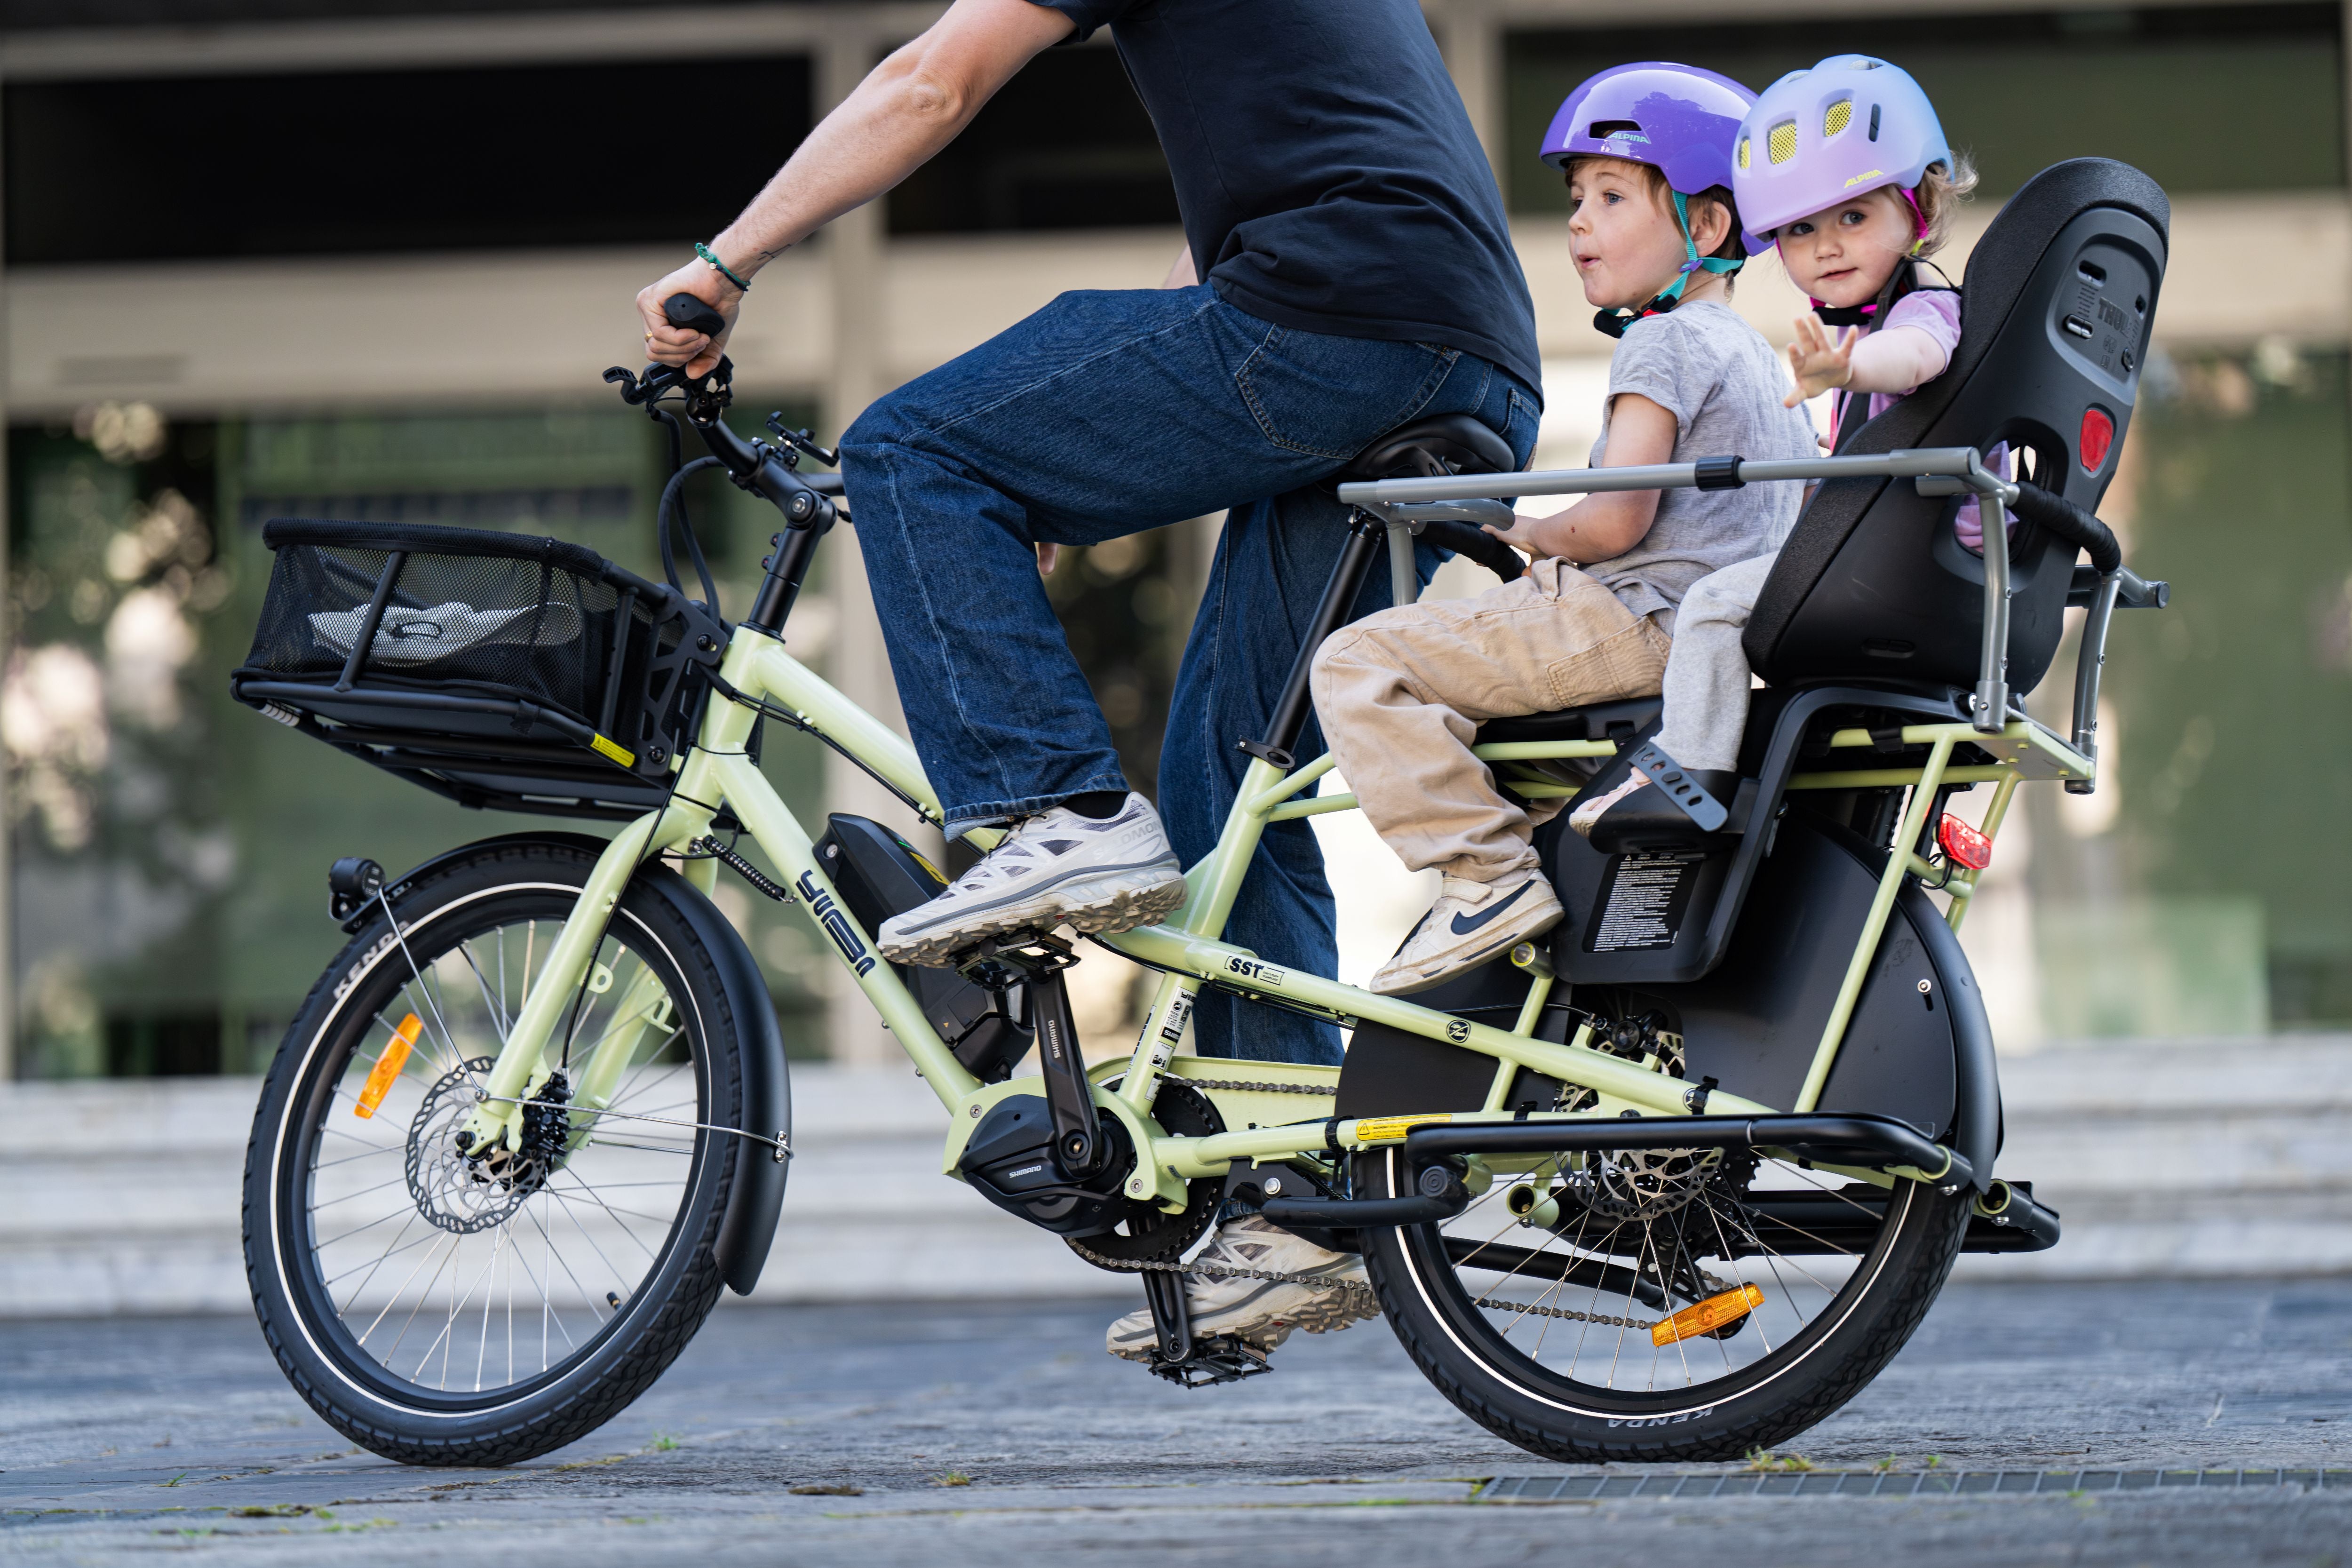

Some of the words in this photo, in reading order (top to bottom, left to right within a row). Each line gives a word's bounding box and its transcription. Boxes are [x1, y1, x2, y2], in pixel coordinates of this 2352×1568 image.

[1608, 133, 1650, 143] ALPINA
[1844, 169, 1884, 188] ALPINA
[795, 869, 876, 979] YUBA
[333, 920, 410, 1000] KENDA
[1230, 958, 1265, 979] SST
[1048, 1020, 1061, 1058] SHIMANO
[1009, 1165, 1041, 1178] SHIMANO
[1607, 1406, 1715, 1427] KENDA
